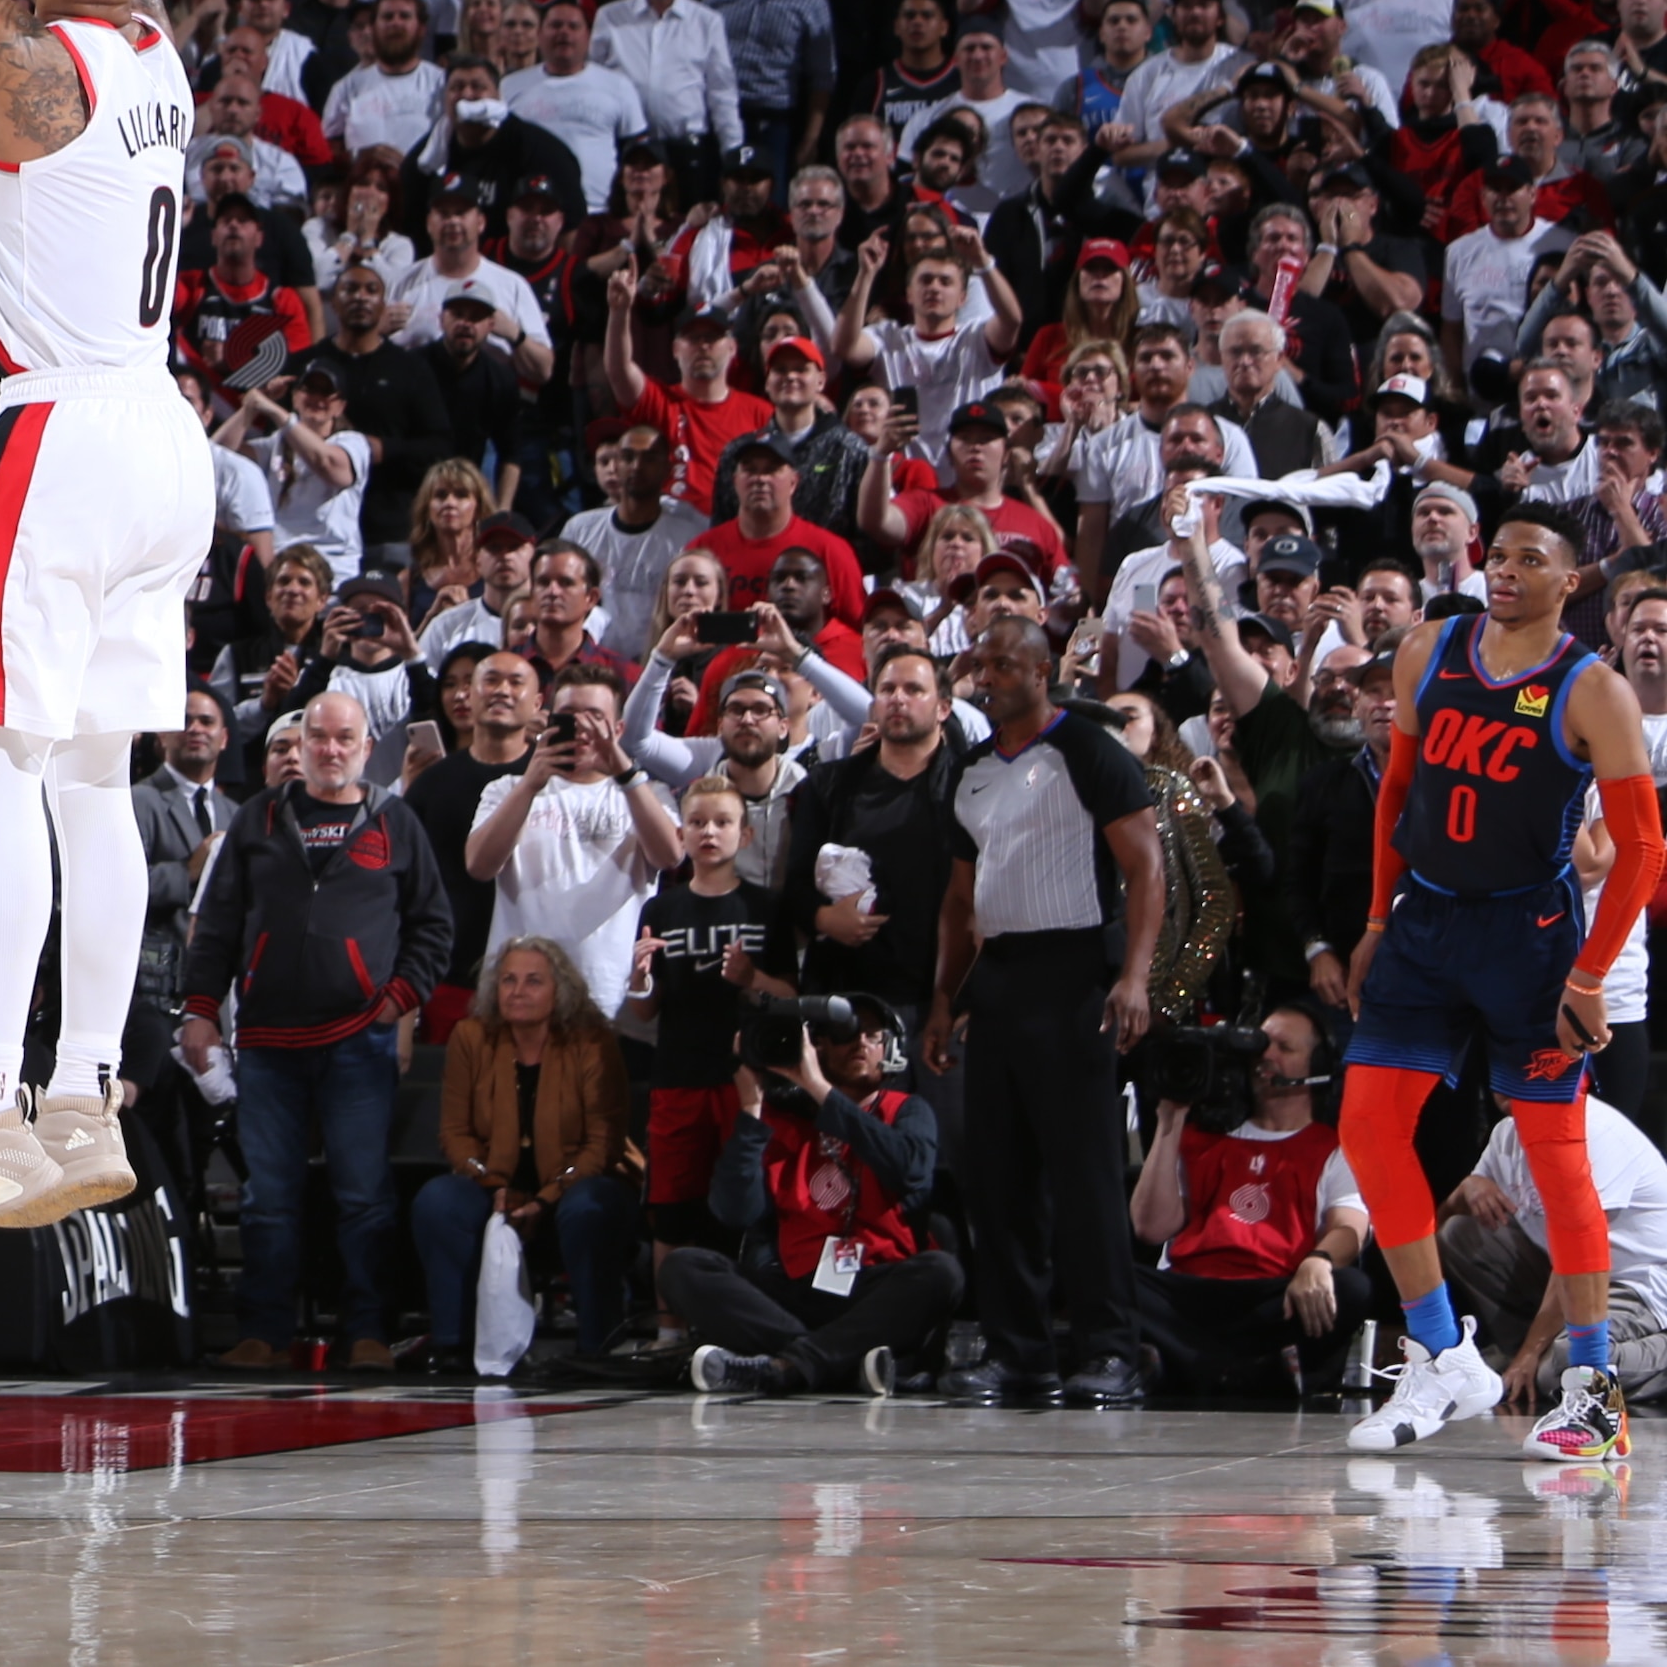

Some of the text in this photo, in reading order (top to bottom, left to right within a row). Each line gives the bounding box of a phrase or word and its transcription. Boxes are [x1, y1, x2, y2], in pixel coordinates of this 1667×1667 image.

[138, 185, 177, 328] 0
[1423, 706, 1540, 783] OKC
[1445, 784, 1479, 842] 0
[660, 923, 766, 958] ELITE
